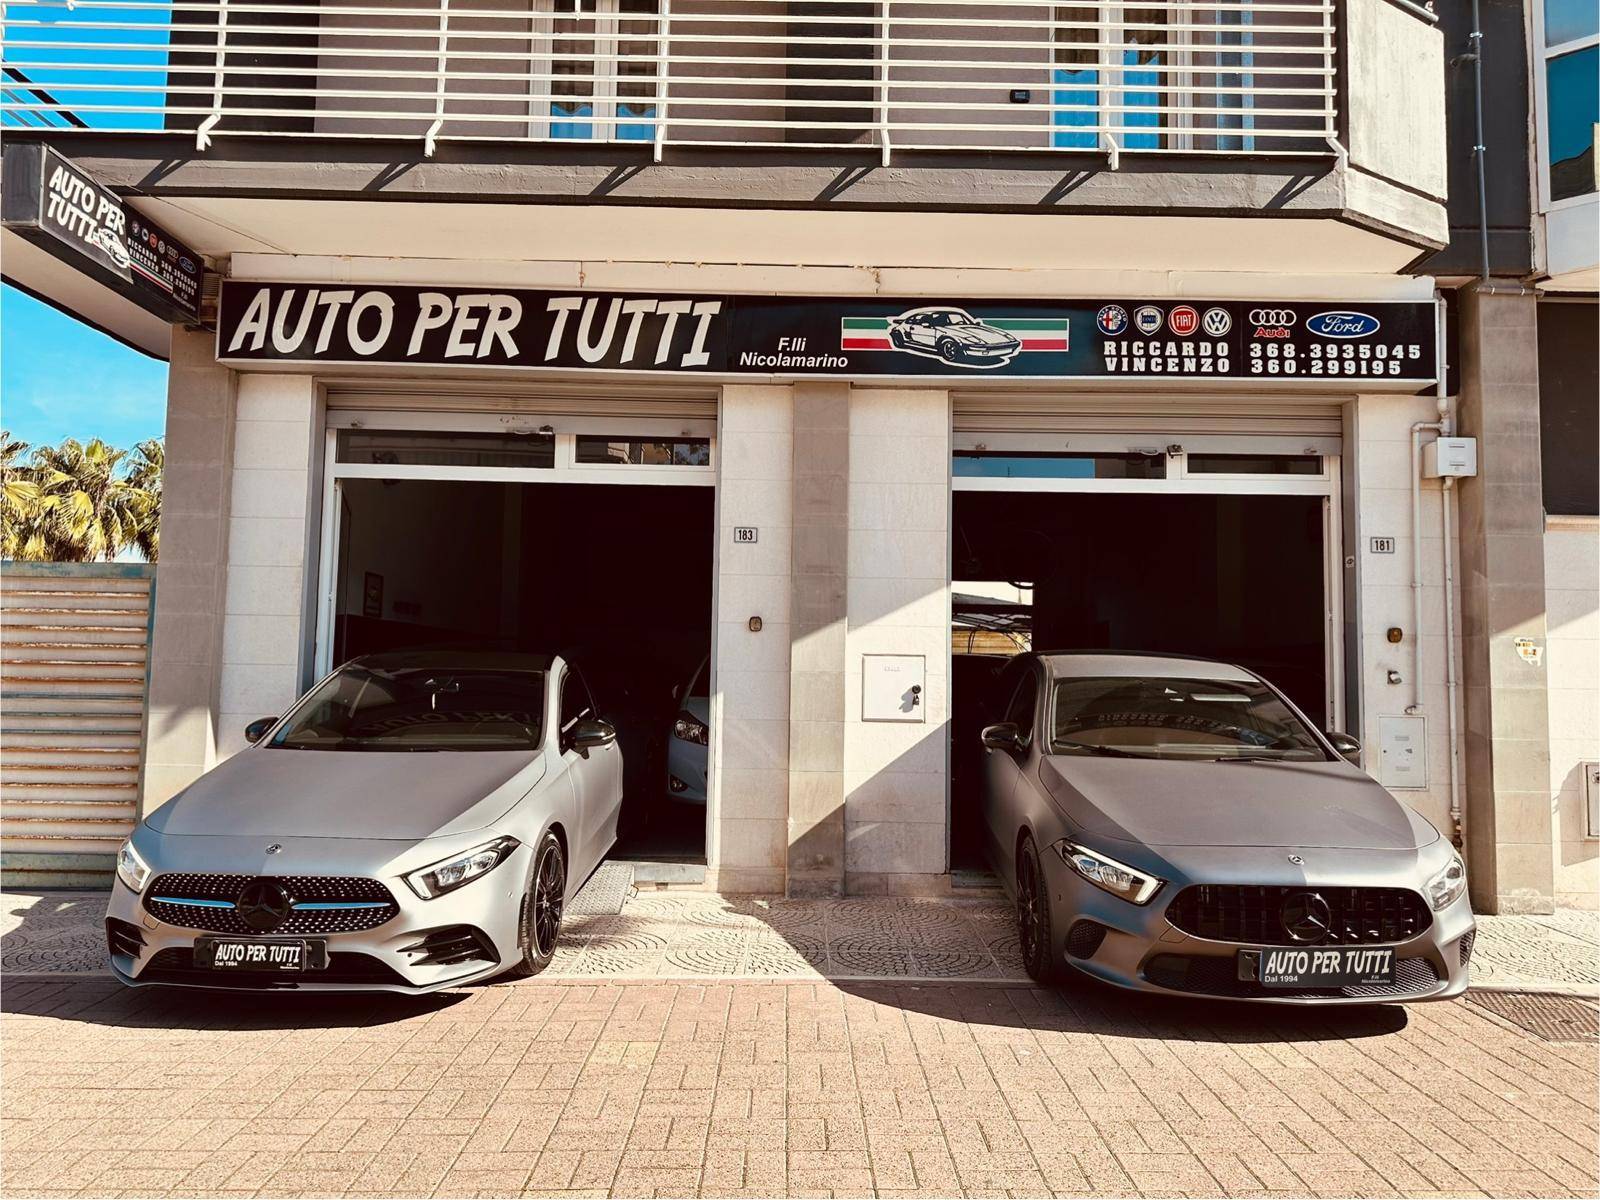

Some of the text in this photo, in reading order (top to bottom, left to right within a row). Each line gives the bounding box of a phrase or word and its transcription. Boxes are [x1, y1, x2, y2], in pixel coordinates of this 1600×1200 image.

[49, 165, 125, 236] AUTO PER
[47, 191, 99, 245] TUTTI
[127, 237, 157, 262] RICCARDO
[129, 247, 159, 272] VINCENZO
[228, 288, 722, 368] AUTO PER TUTTI
[1175, 314, 1192, 327] FIAT
[1321, 314, 1365, 333] Ford
[1253, 327, 1291, 338] Audi
[1103, 341, 1229, 357] RICCARDO
[1249, 343, 1421, 359] 368.3935045
[739, 352, 848, 368] Nicolamarino
[1105, 357, 1230, 373] VINCENZO
[1251, 359, 1401, 375] 360.299195
[738, 529, 753, 541] 183
[1375, 540, 1390, 551] 181
[215, 944, 301, 963] AUTO PER TUTTI
[1265, 950, 1392, 974] AUTO PER TUTTI
[1264, 975, 1299, 983] Dal 1994
